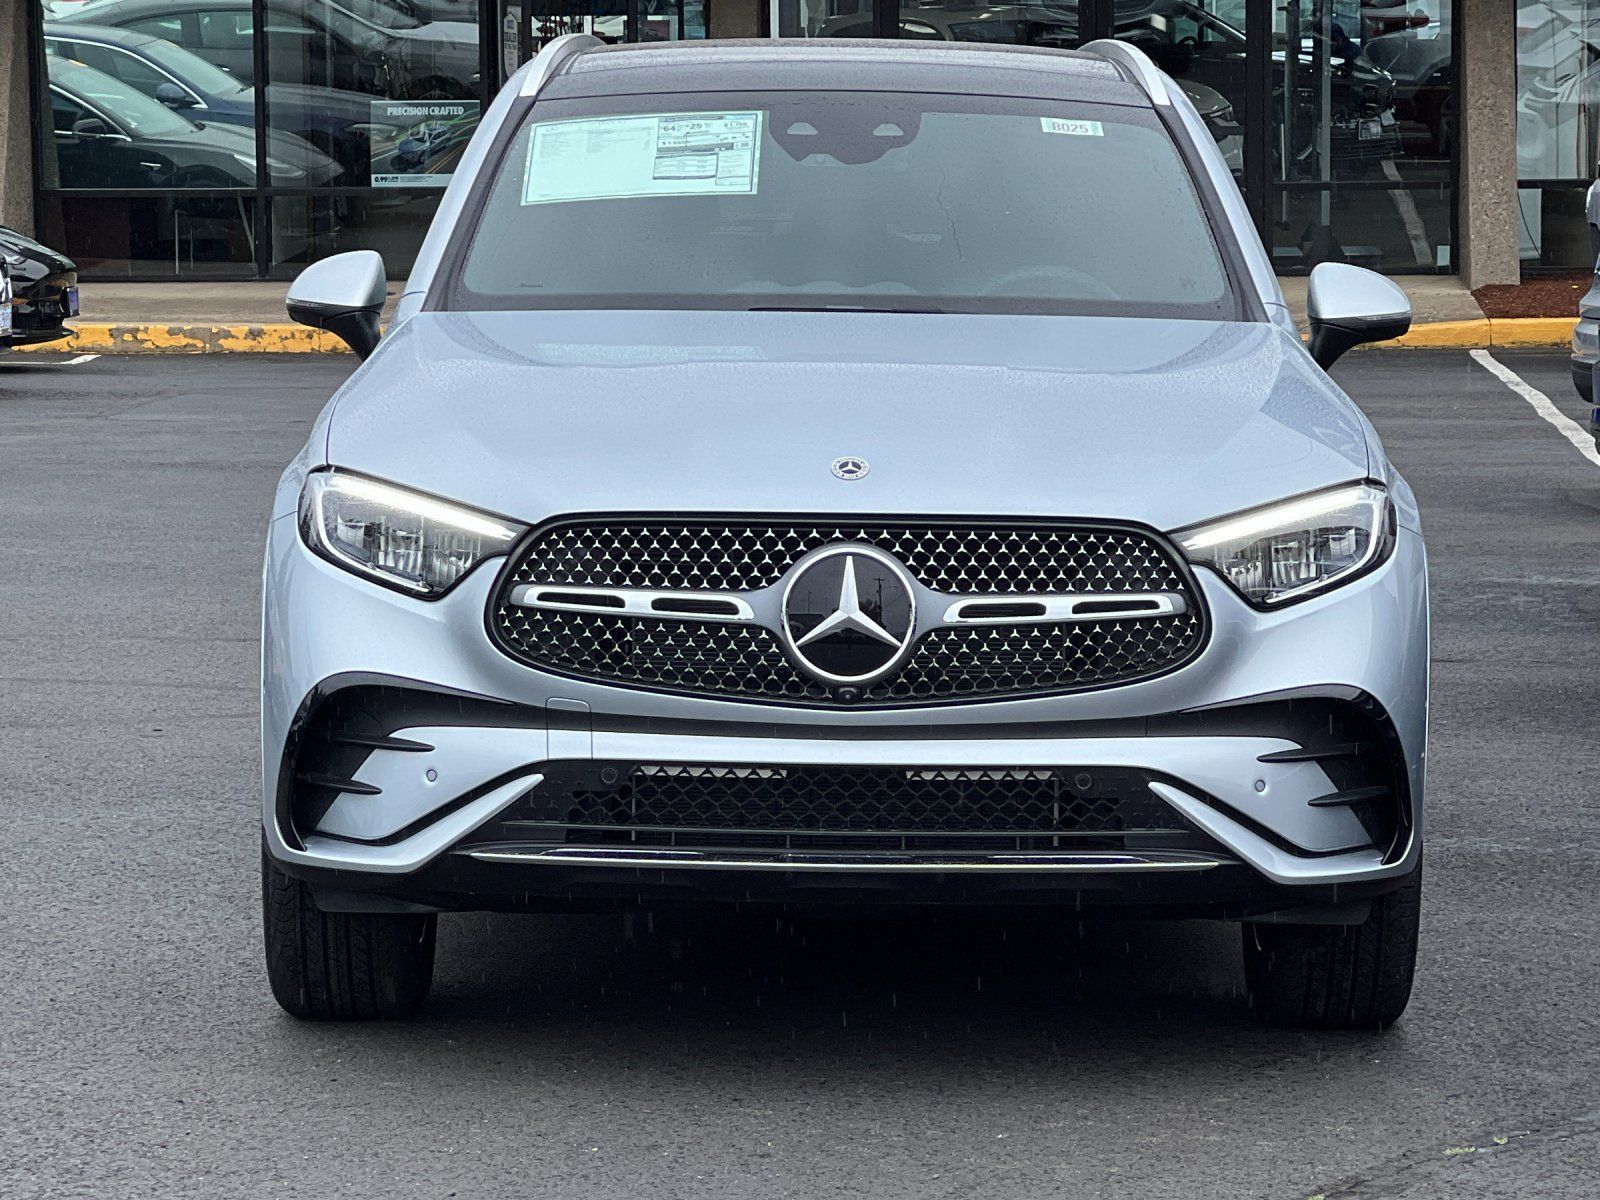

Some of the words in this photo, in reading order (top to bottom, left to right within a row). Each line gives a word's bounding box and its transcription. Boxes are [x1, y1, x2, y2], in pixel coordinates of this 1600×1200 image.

[387, 106, 428, 116] PRECISION
[429, 106, 465, 116] CRAFTED
[1052, 121, 1089, 134] 8025
